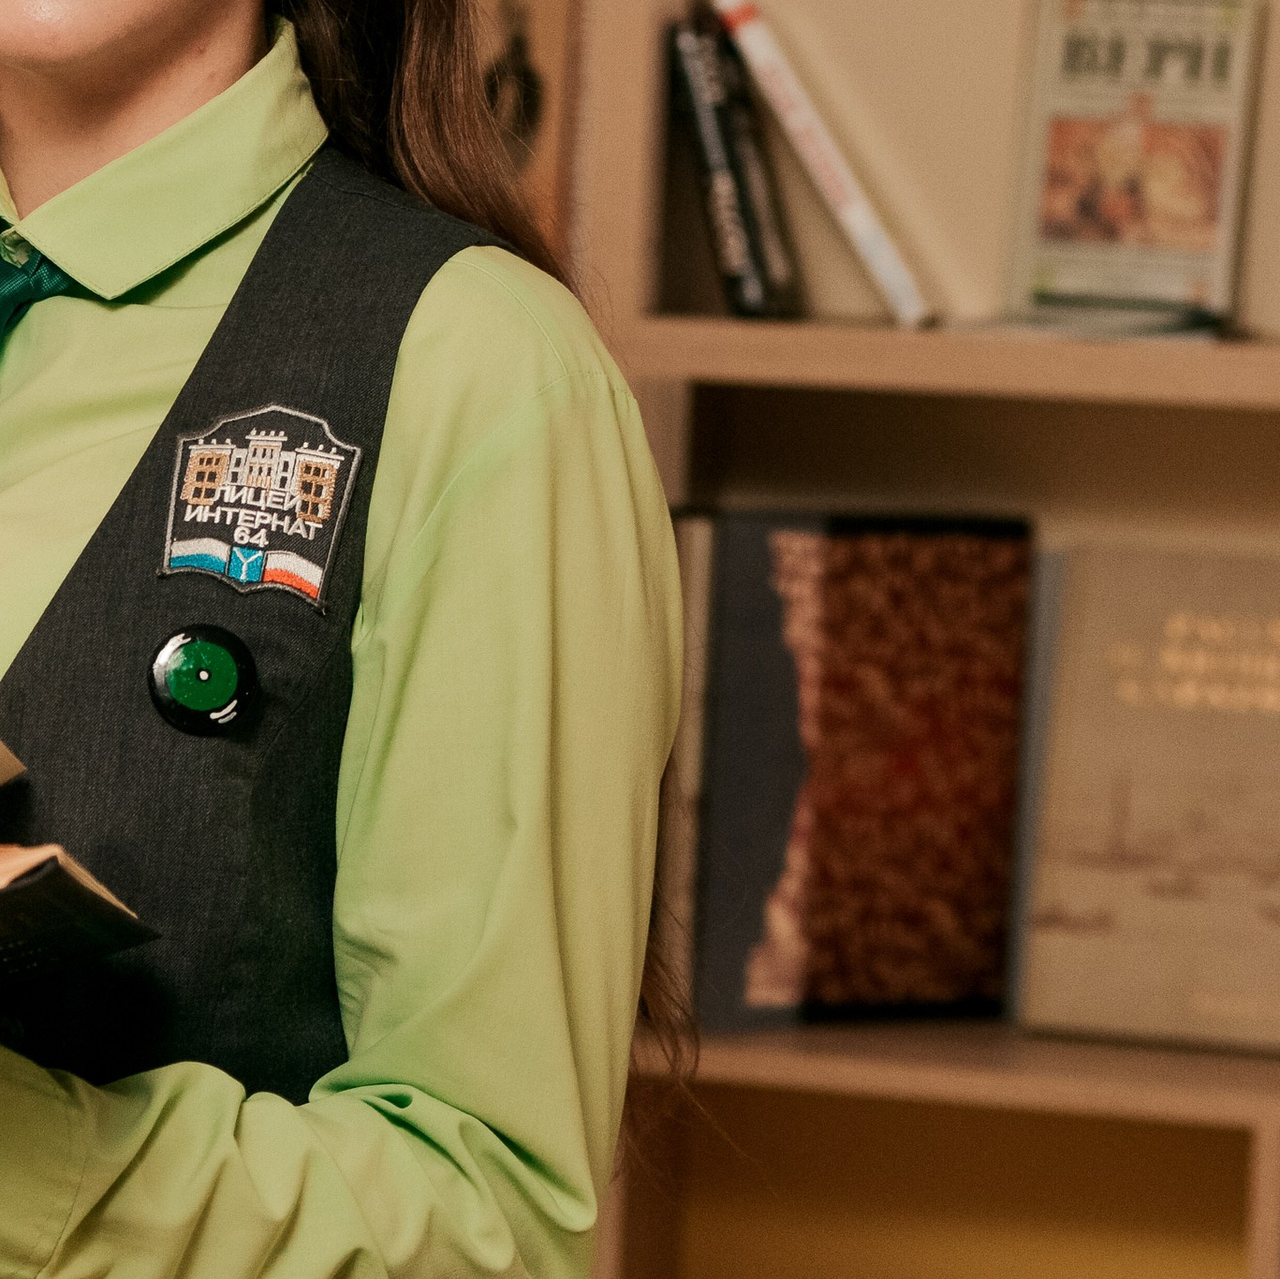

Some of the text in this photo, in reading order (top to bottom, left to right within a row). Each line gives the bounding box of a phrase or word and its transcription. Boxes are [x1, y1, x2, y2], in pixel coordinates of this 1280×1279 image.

[214, 485, 302, 512] ЛИЦЕЙ
[184, 504, 323, 540] ИНТЕРНАТ
[233, 525, 270, 548] 64
